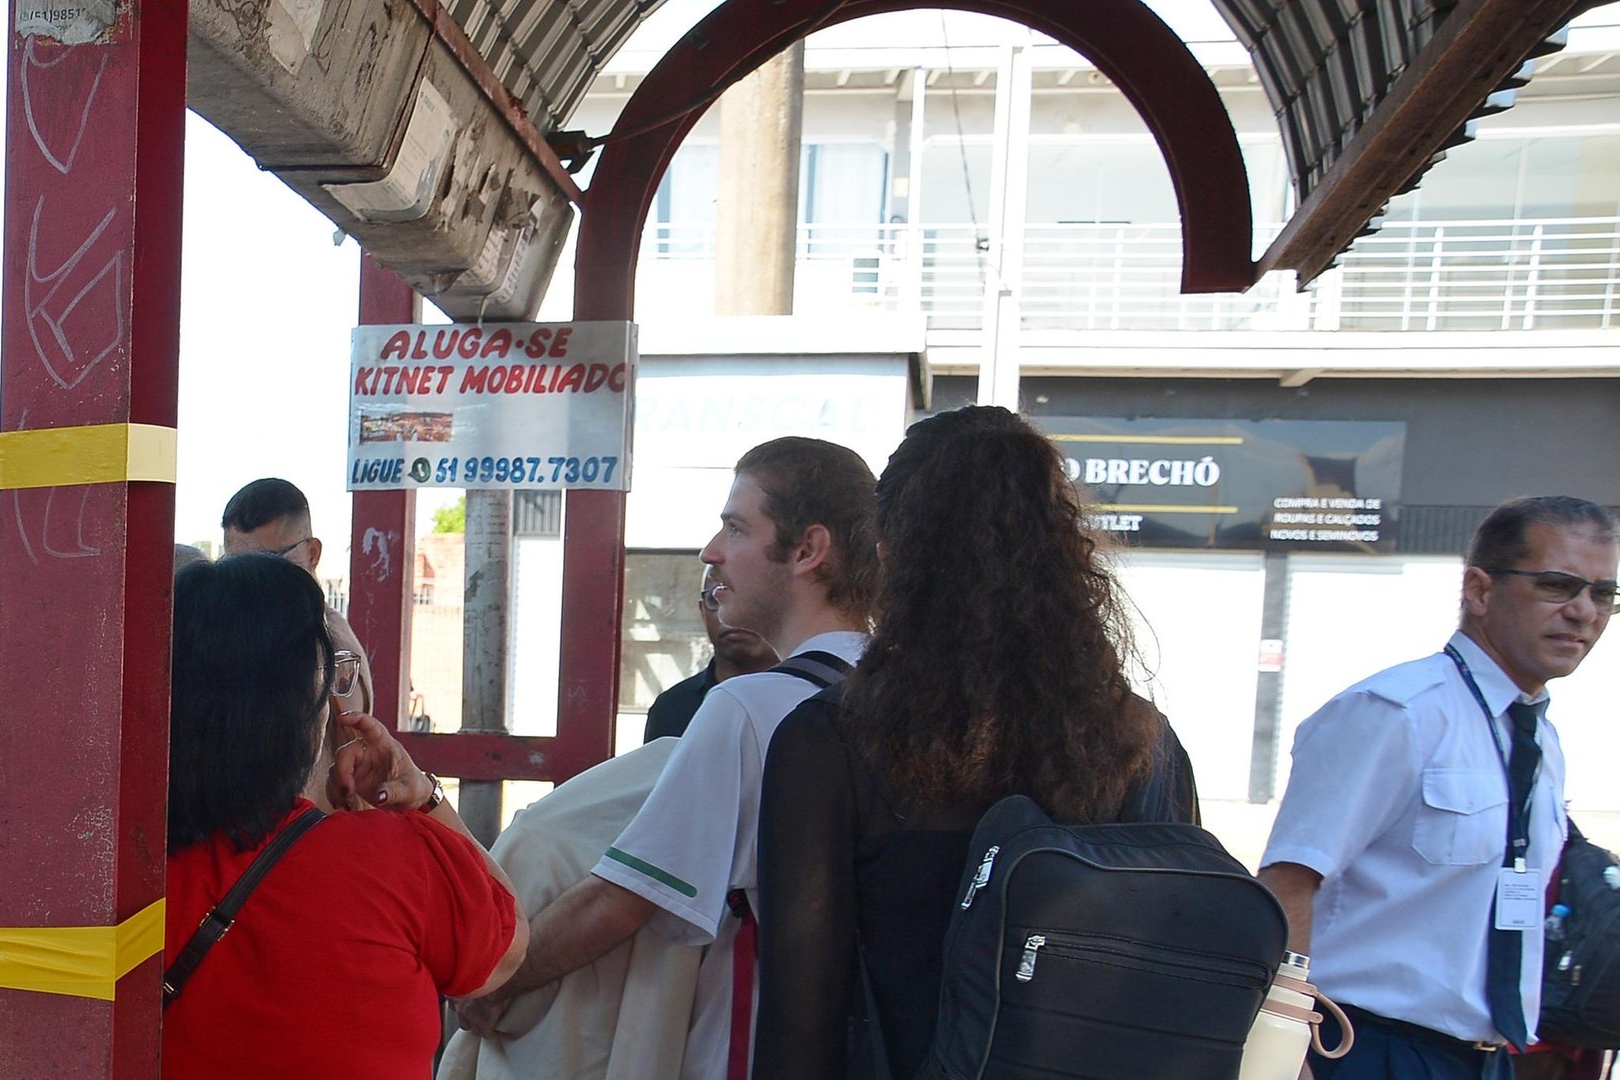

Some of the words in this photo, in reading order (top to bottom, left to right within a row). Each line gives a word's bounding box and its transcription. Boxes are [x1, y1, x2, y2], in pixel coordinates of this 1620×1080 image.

[355, 365, 455, 396] KITNET
[351, 458, 405, 484] LIGUE
[435, 457, 458, 483] 51
[464, 456, 618, 484] 99987.7307
[1085, 455, 1221, 487] BRECHÓ
[1365, 499, 1381, 509] DE
[1270, 529, 1308, 540] NOVOS
